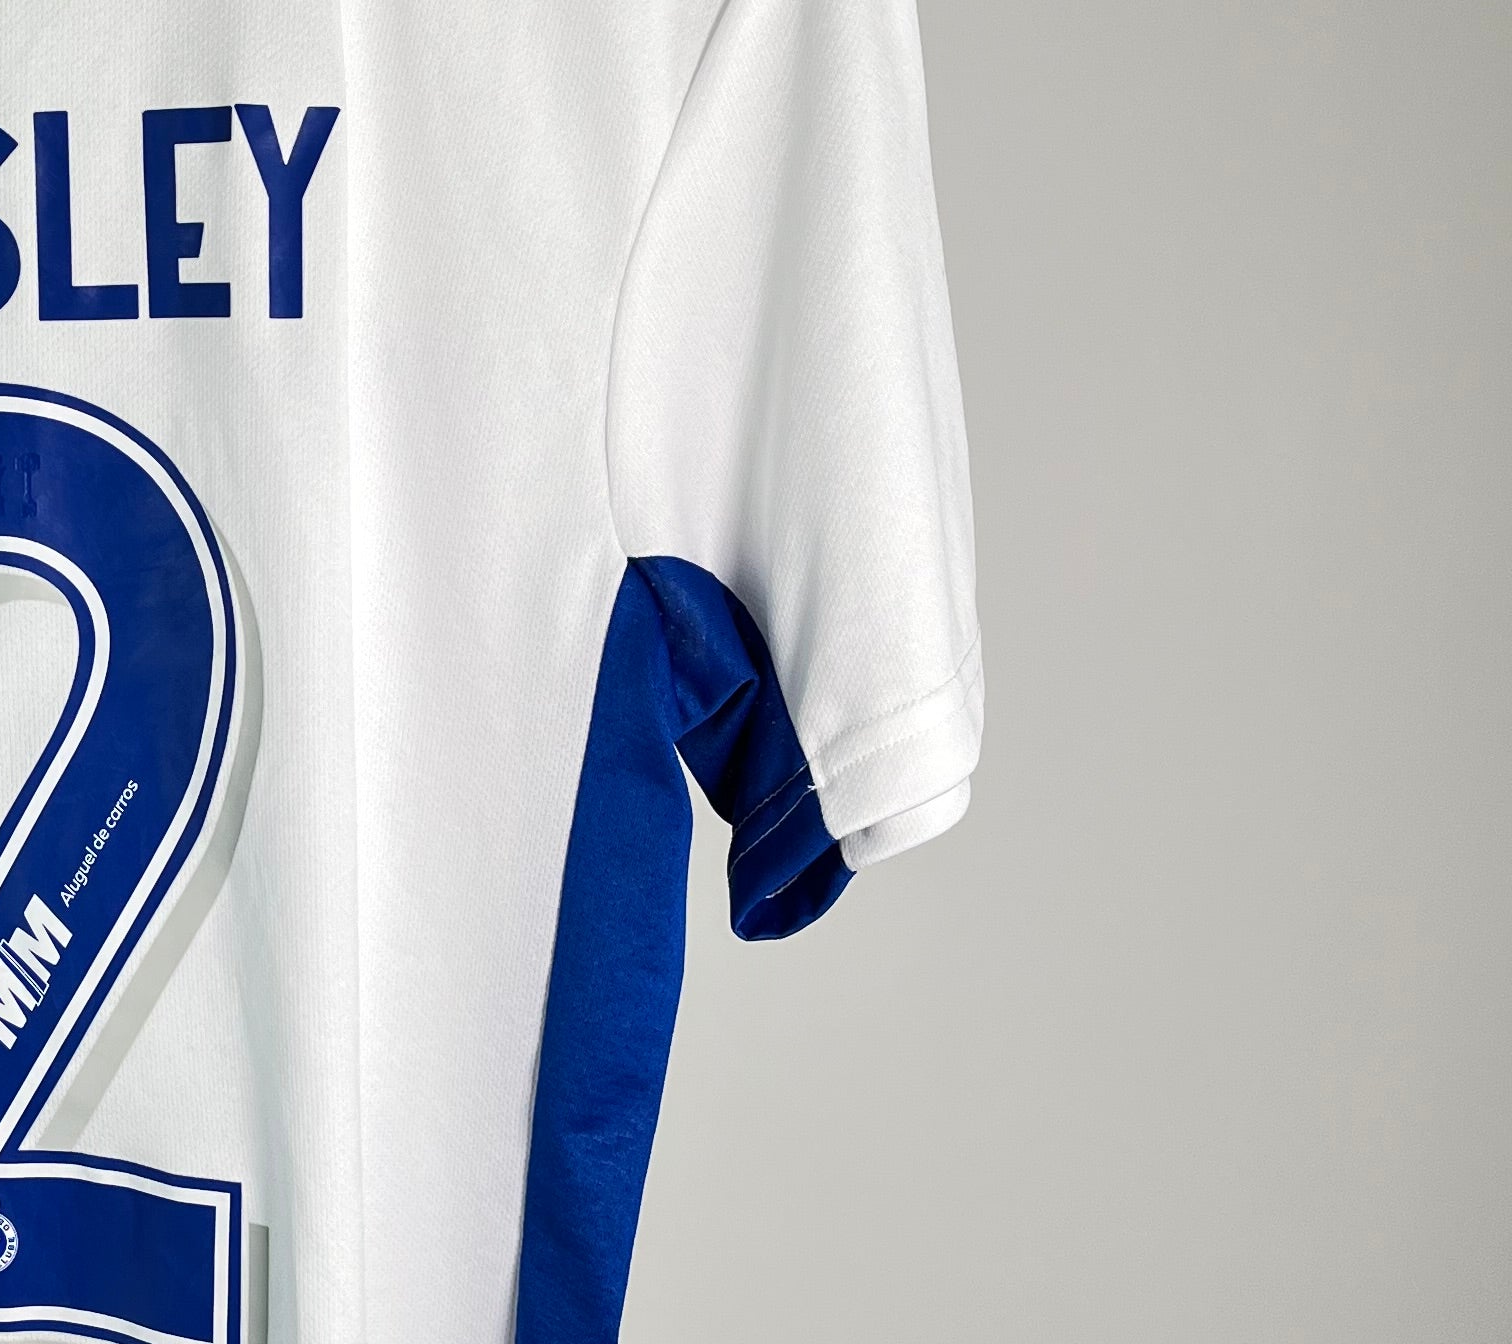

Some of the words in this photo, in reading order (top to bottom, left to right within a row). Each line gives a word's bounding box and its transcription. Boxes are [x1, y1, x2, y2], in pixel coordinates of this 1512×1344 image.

[59, 846, 99, 908] Aluguel
[92, 826, 111, 851] de
[105, 779, 139, 830] carros
